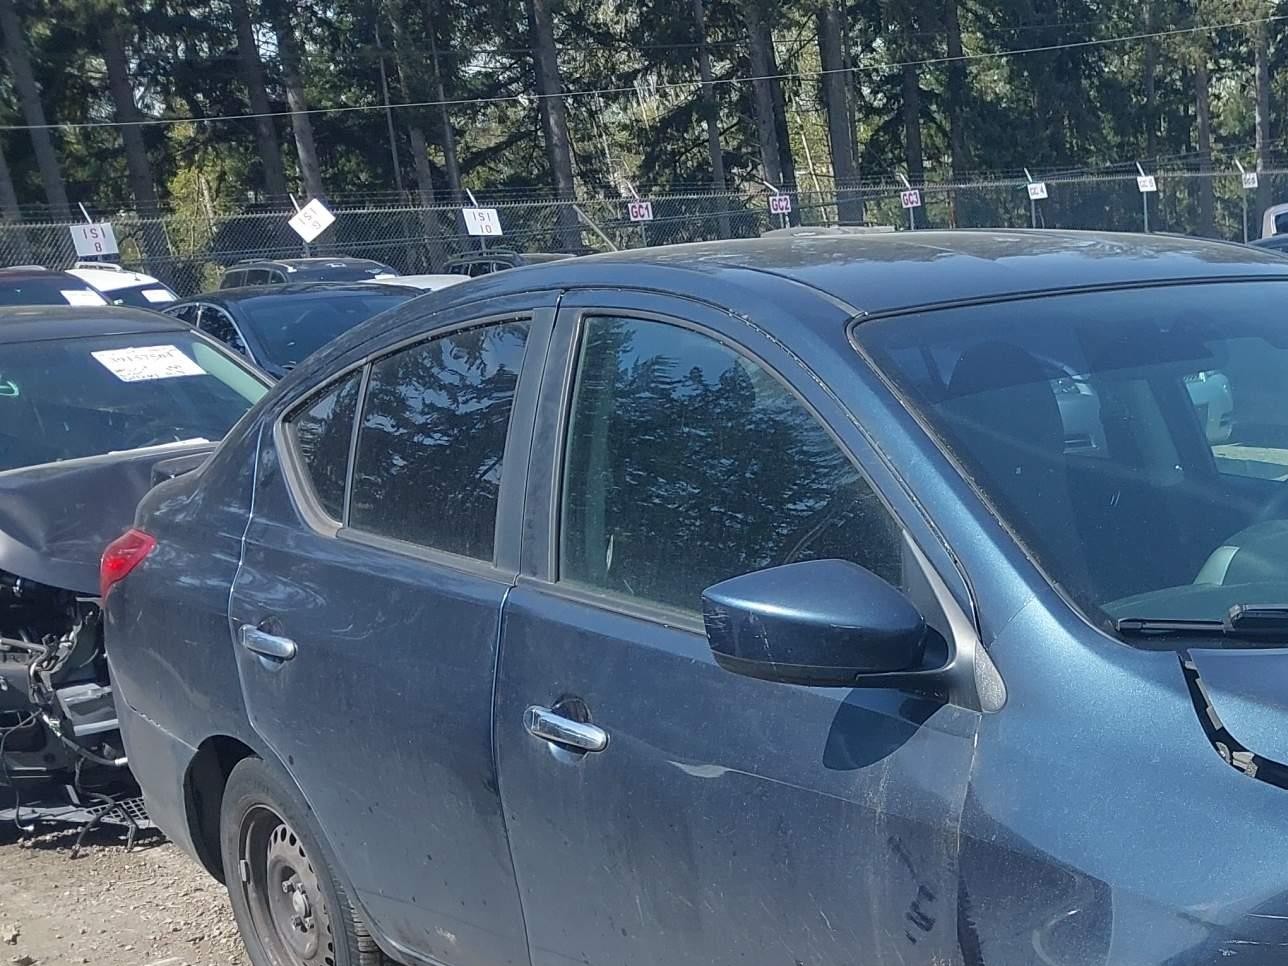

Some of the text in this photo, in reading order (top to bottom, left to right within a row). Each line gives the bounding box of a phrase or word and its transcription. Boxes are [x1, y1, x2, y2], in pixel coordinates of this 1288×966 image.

[771, 197, 790, 211] GC2
[902, 191, 919, 206] GC3
[630, 204, 650, 219] GC1
[94, 242, 103, 253] 8
